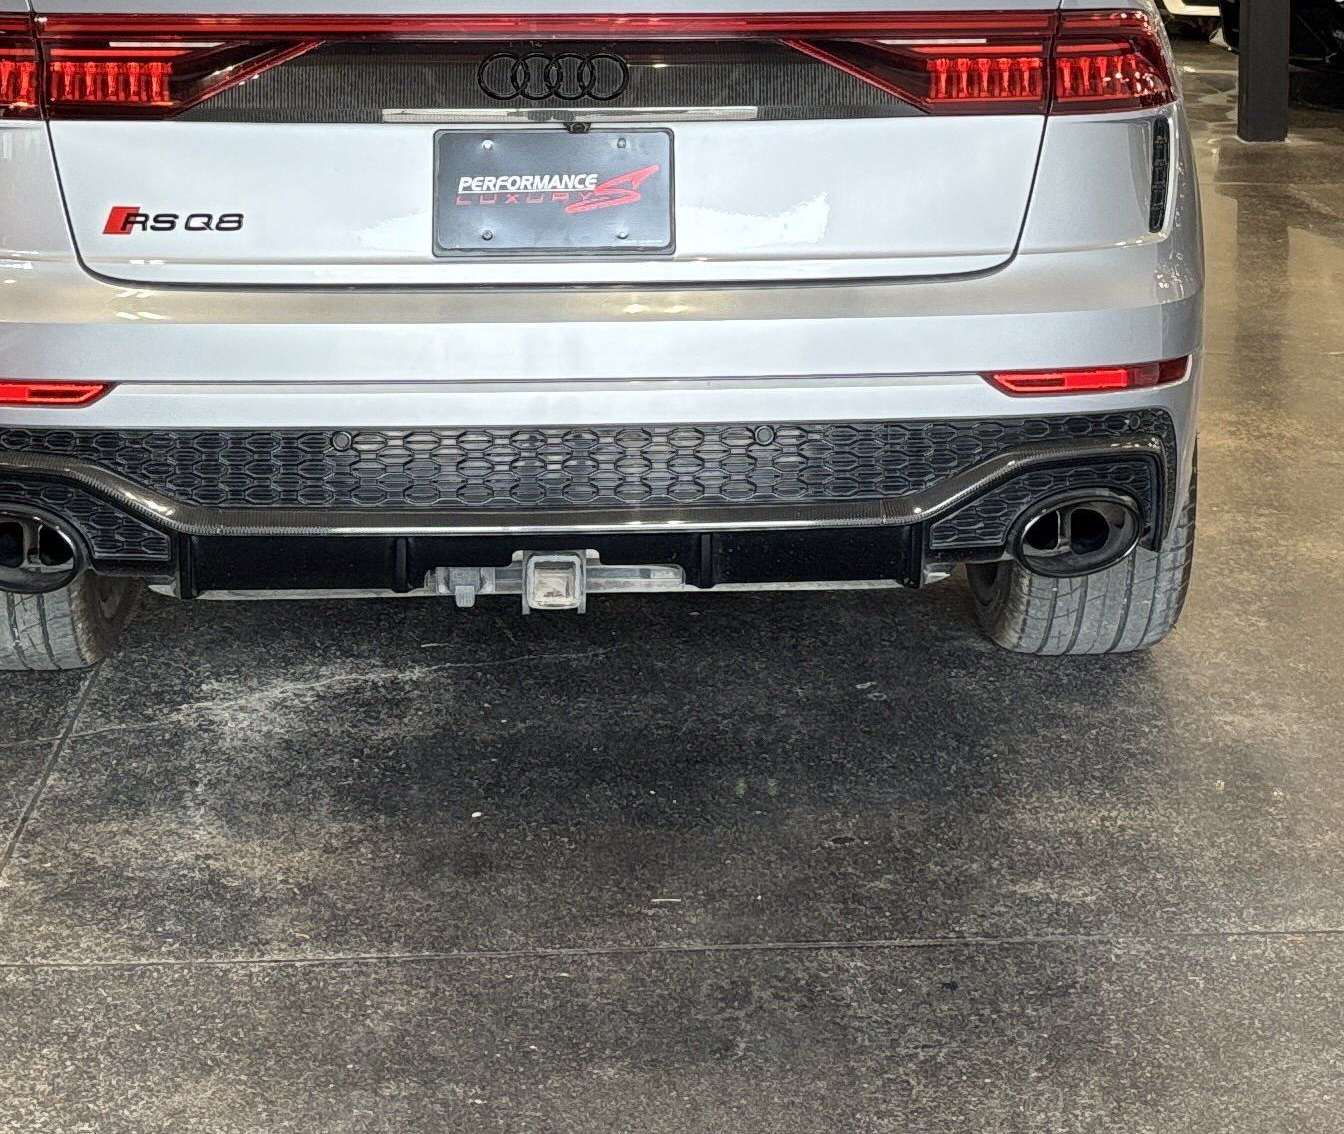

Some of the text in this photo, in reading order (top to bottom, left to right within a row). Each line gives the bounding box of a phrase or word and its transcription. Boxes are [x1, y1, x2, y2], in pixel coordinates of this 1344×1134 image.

[458, 173, 598, 194] PERFORMANCE
[456, 192, 594, 206] LUXURY
[120, 212, 244, 232] RS Q8
